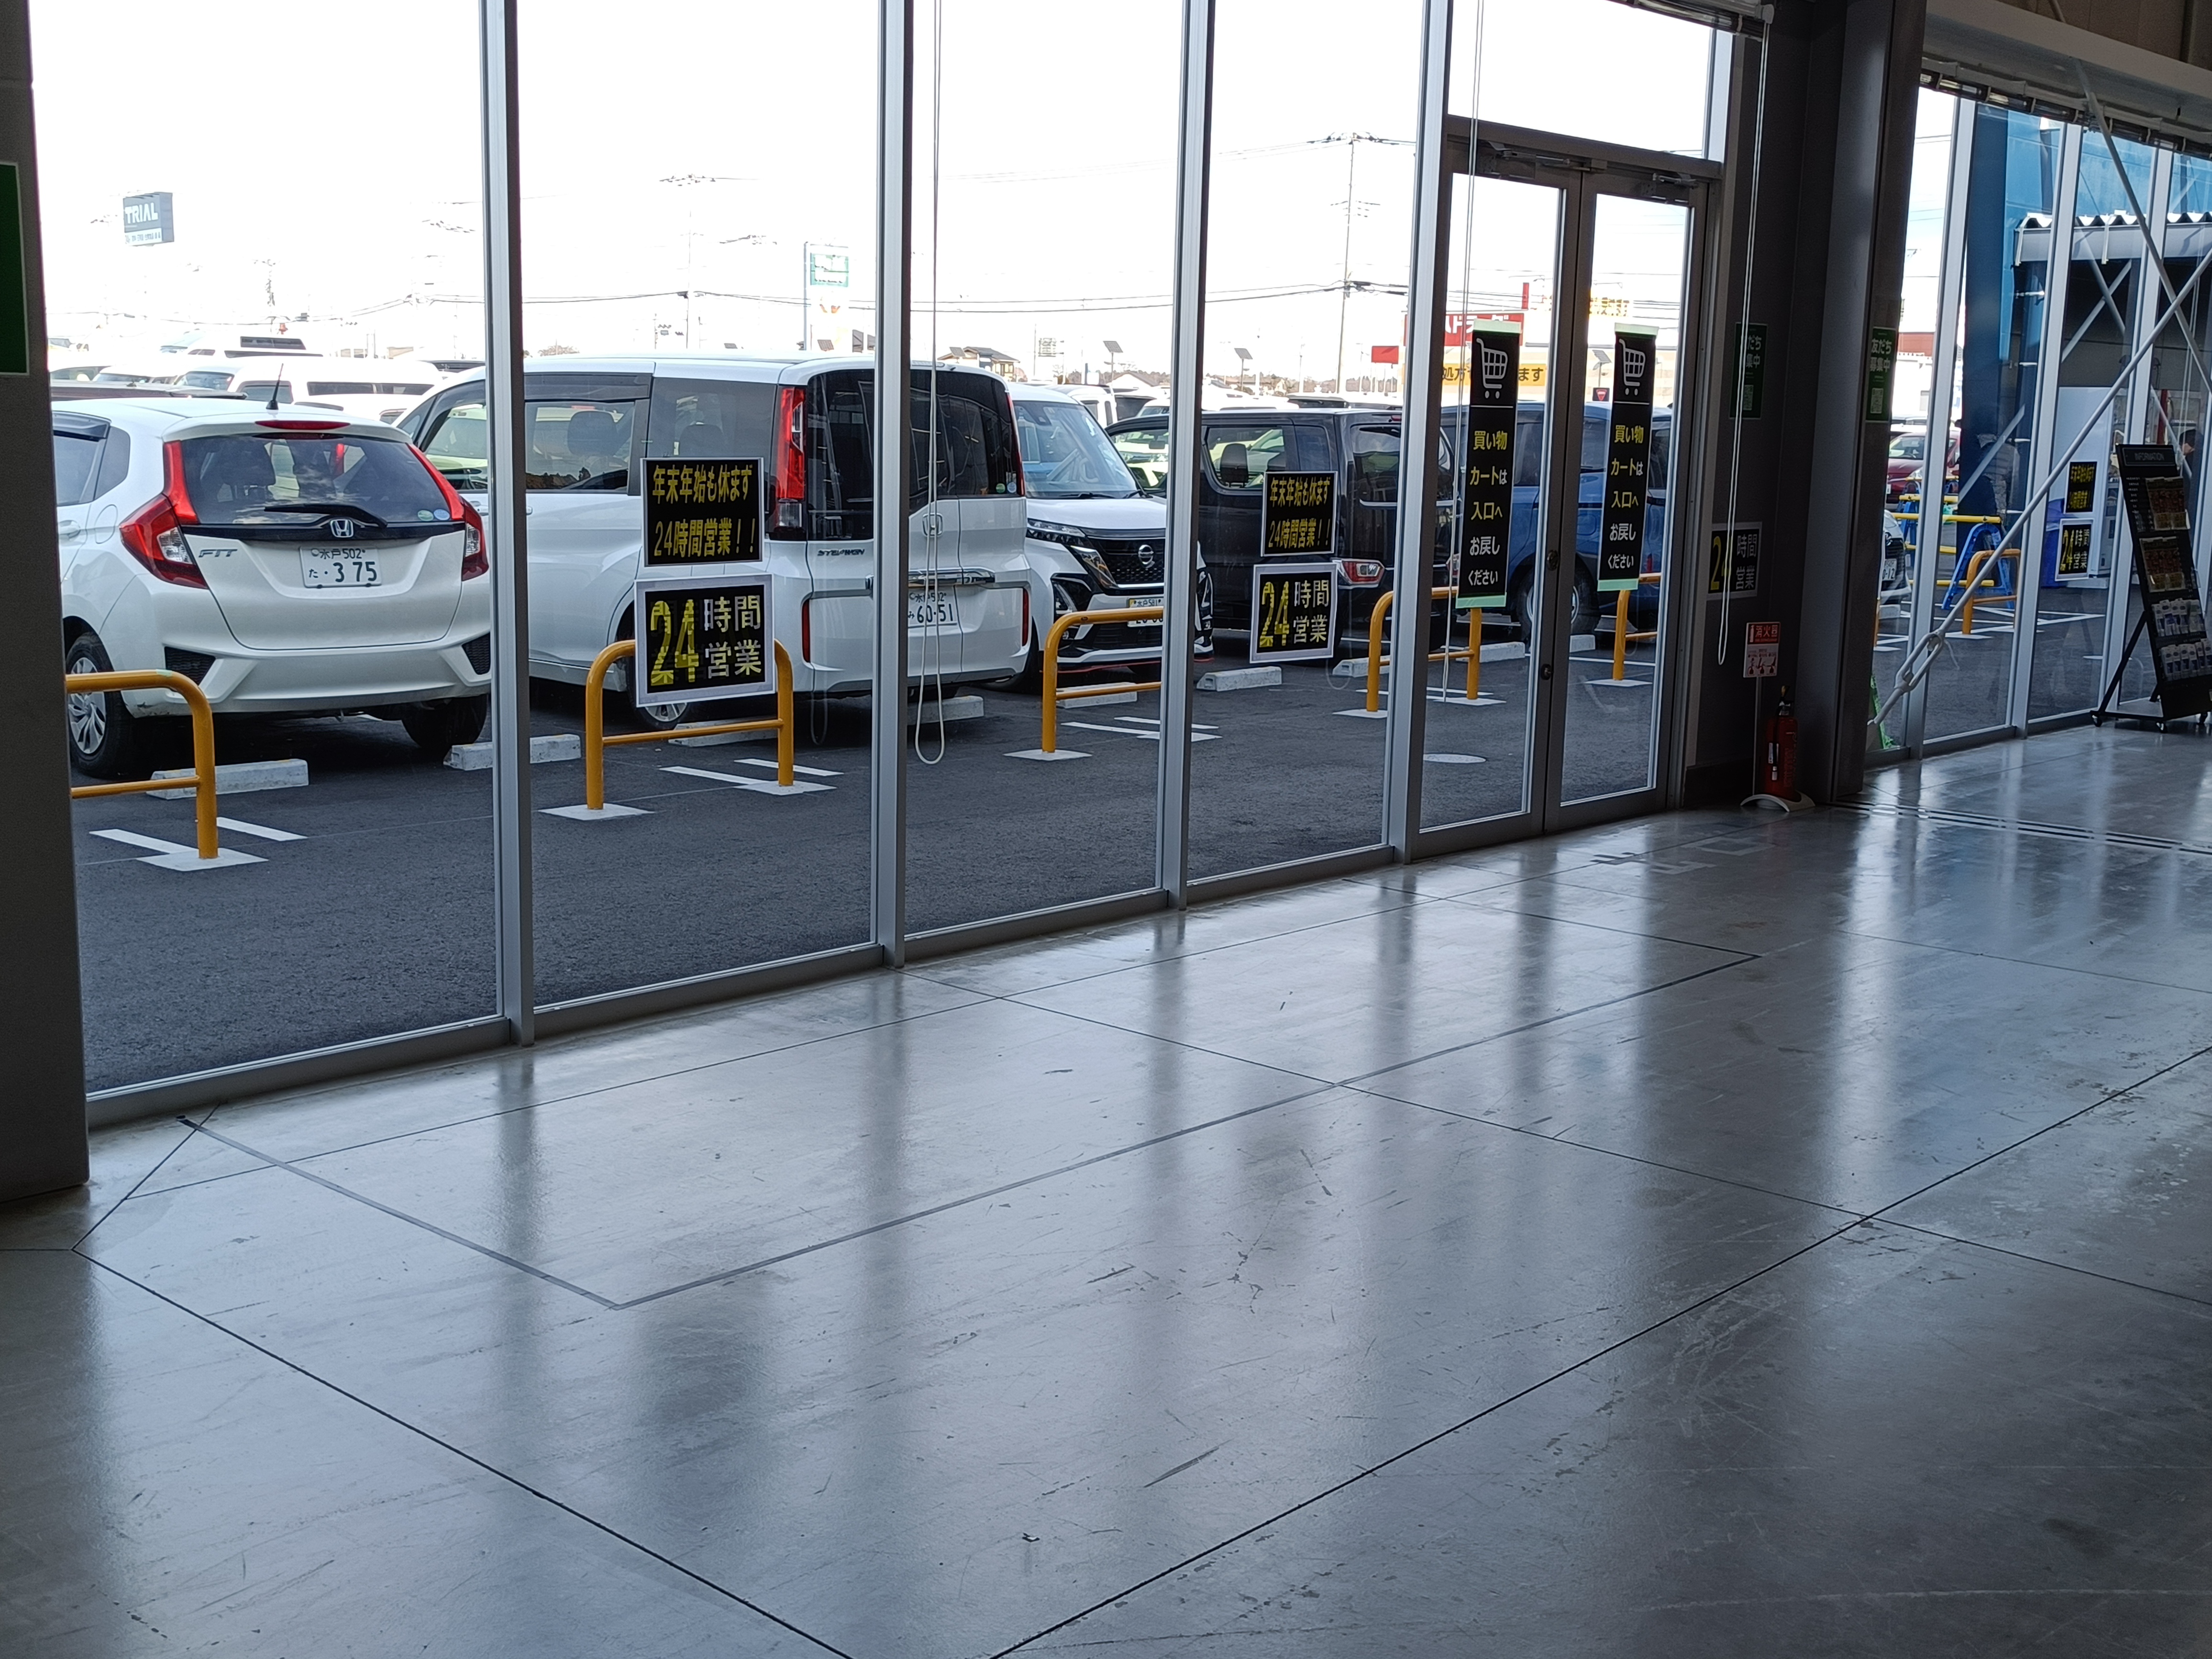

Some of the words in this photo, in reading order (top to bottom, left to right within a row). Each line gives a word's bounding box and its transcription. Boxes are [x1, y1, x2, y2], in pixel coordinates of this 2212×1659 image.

[125, 202, 158, 224] TRIAL
[1744, 334, 1762, 351] だち
[1871, 338, 1892, 355] 友だち
[1743, 353, 1761, 369] 集中
[1473, 431, 1508, 450] 買い物
[1614, 425, 1644, 443] 買い物
[2134, 452, 2165, 462] INFORMATION
[1470, 466, 1508, 485] カートは
[1611, 458, 1644, 476] カートは
[653, 464, 753, 504] 年末年始も休まず
[1270, 476, 1331, 508] 年末年始も休まず
[1611, 491, 1639, 509] 入口へ
[1471, 502, 1503, 520] 入口へ
[1610, 523, 1637, 541] お戻し
[199, 549, 238, 558] FIT
[1470, 536, 1500, 556] お戻し
[1608, 554, 1634, 569] ください
[1468, 569, 1498, 586] ください
[1736, 565, 1755, 590] 営業
[1259, 581, 1290, 647] 24
[1293, 614, 1327, 644] 営業
[651, 599, 699, 686] 24
[705, 640, 762, 679] 営業
